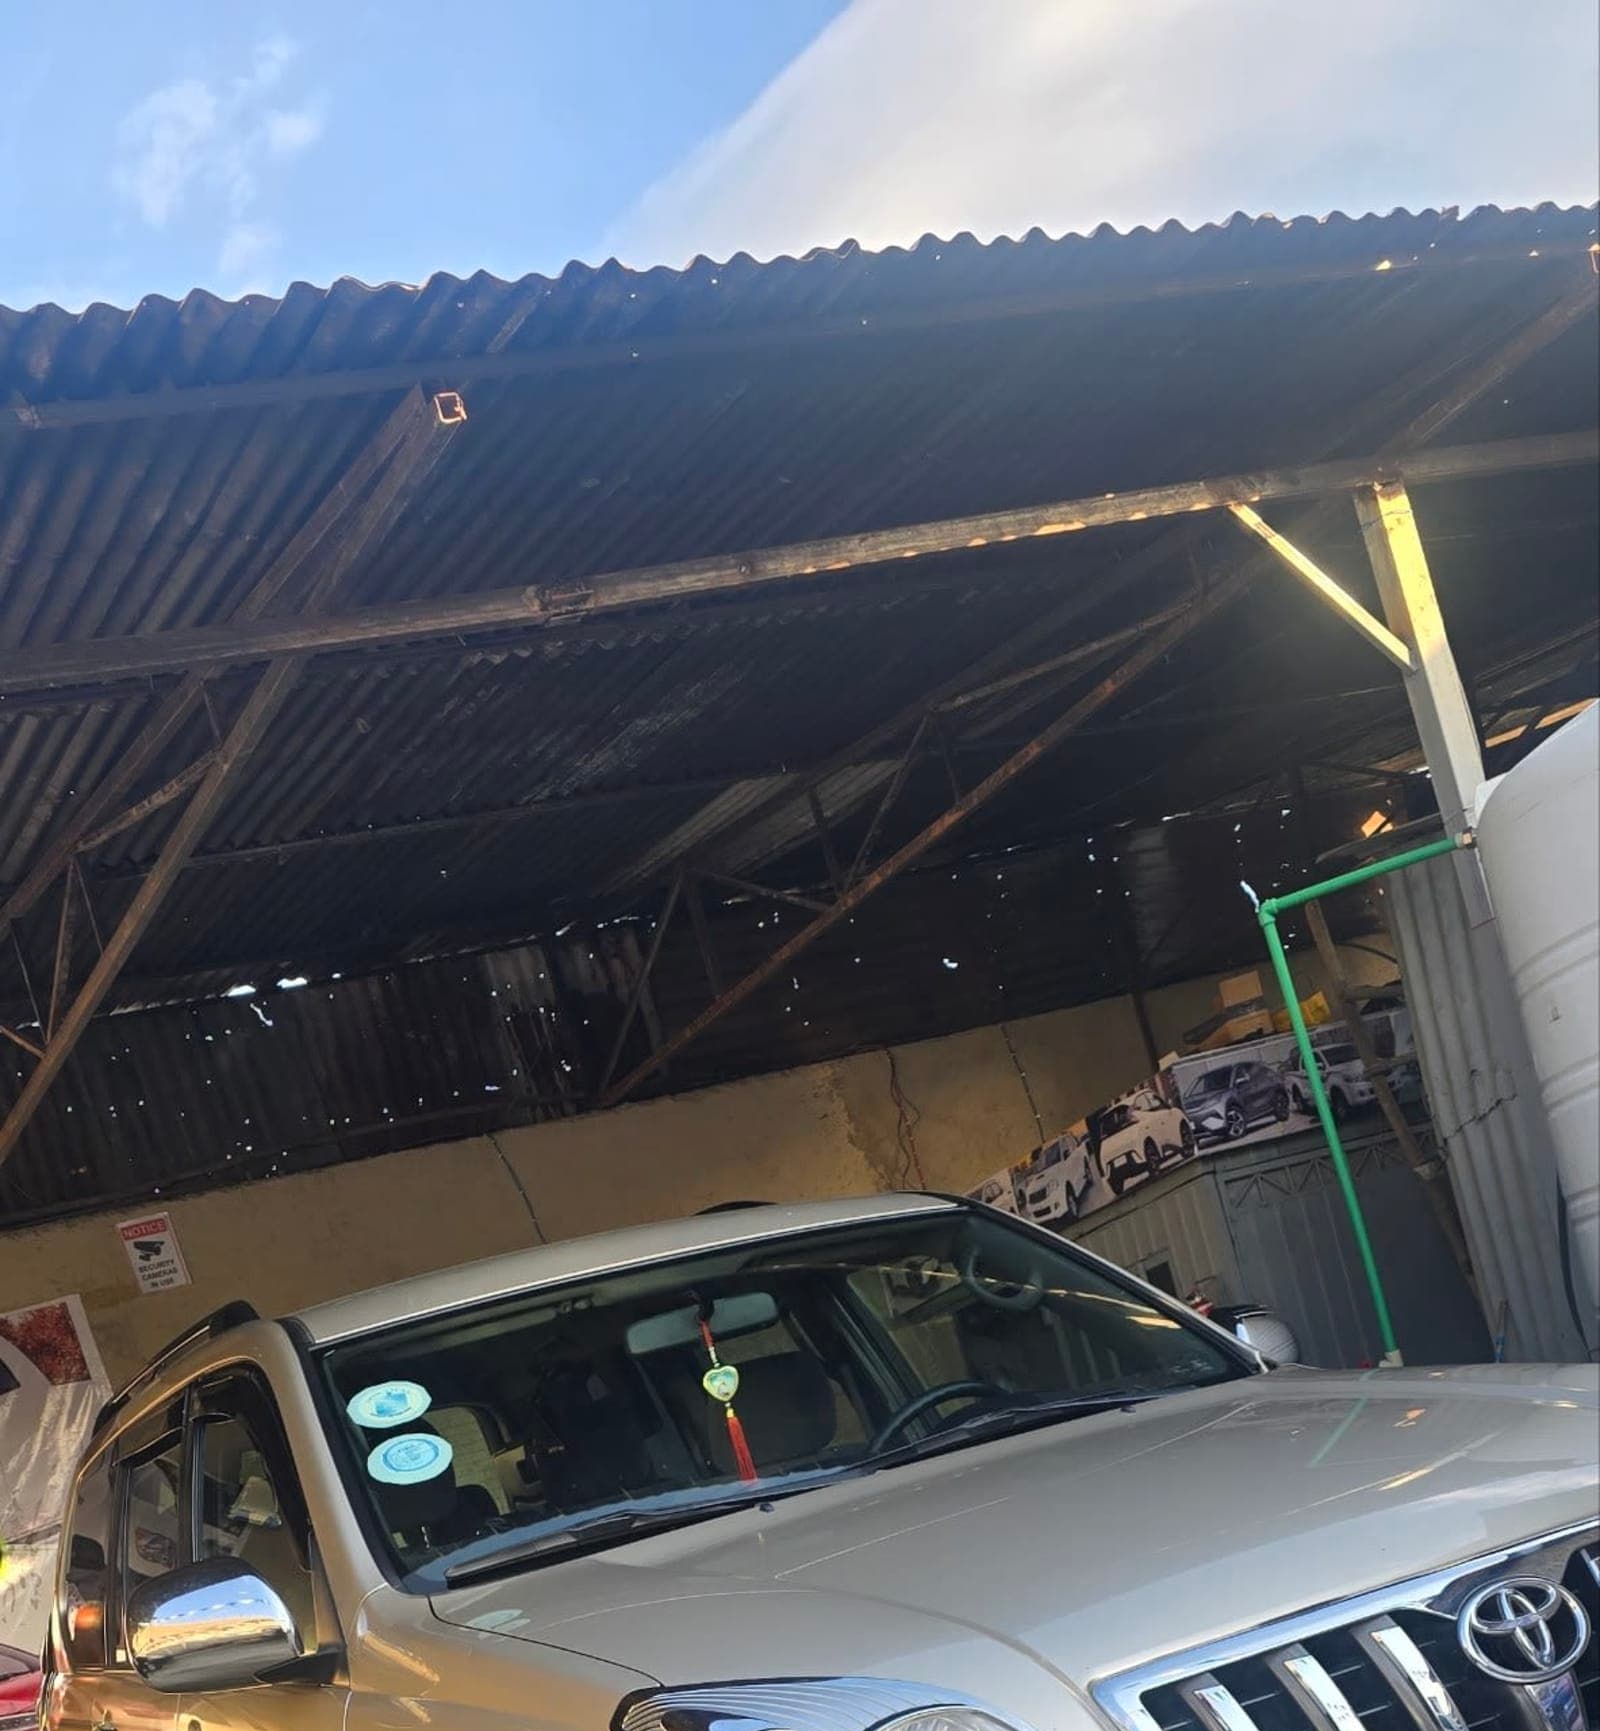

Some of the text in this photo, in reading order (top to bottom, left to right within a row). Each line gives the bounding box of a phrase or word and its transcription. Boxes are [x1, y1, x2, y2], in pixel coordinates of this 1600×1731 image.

[122, 1220, 166, 1238] NOTICE
[139, 1260, 175, 1273] SECURITY
[142, 1267, 178, 1281] CAMERAS
[160, 1277, 174, 1287] USE
